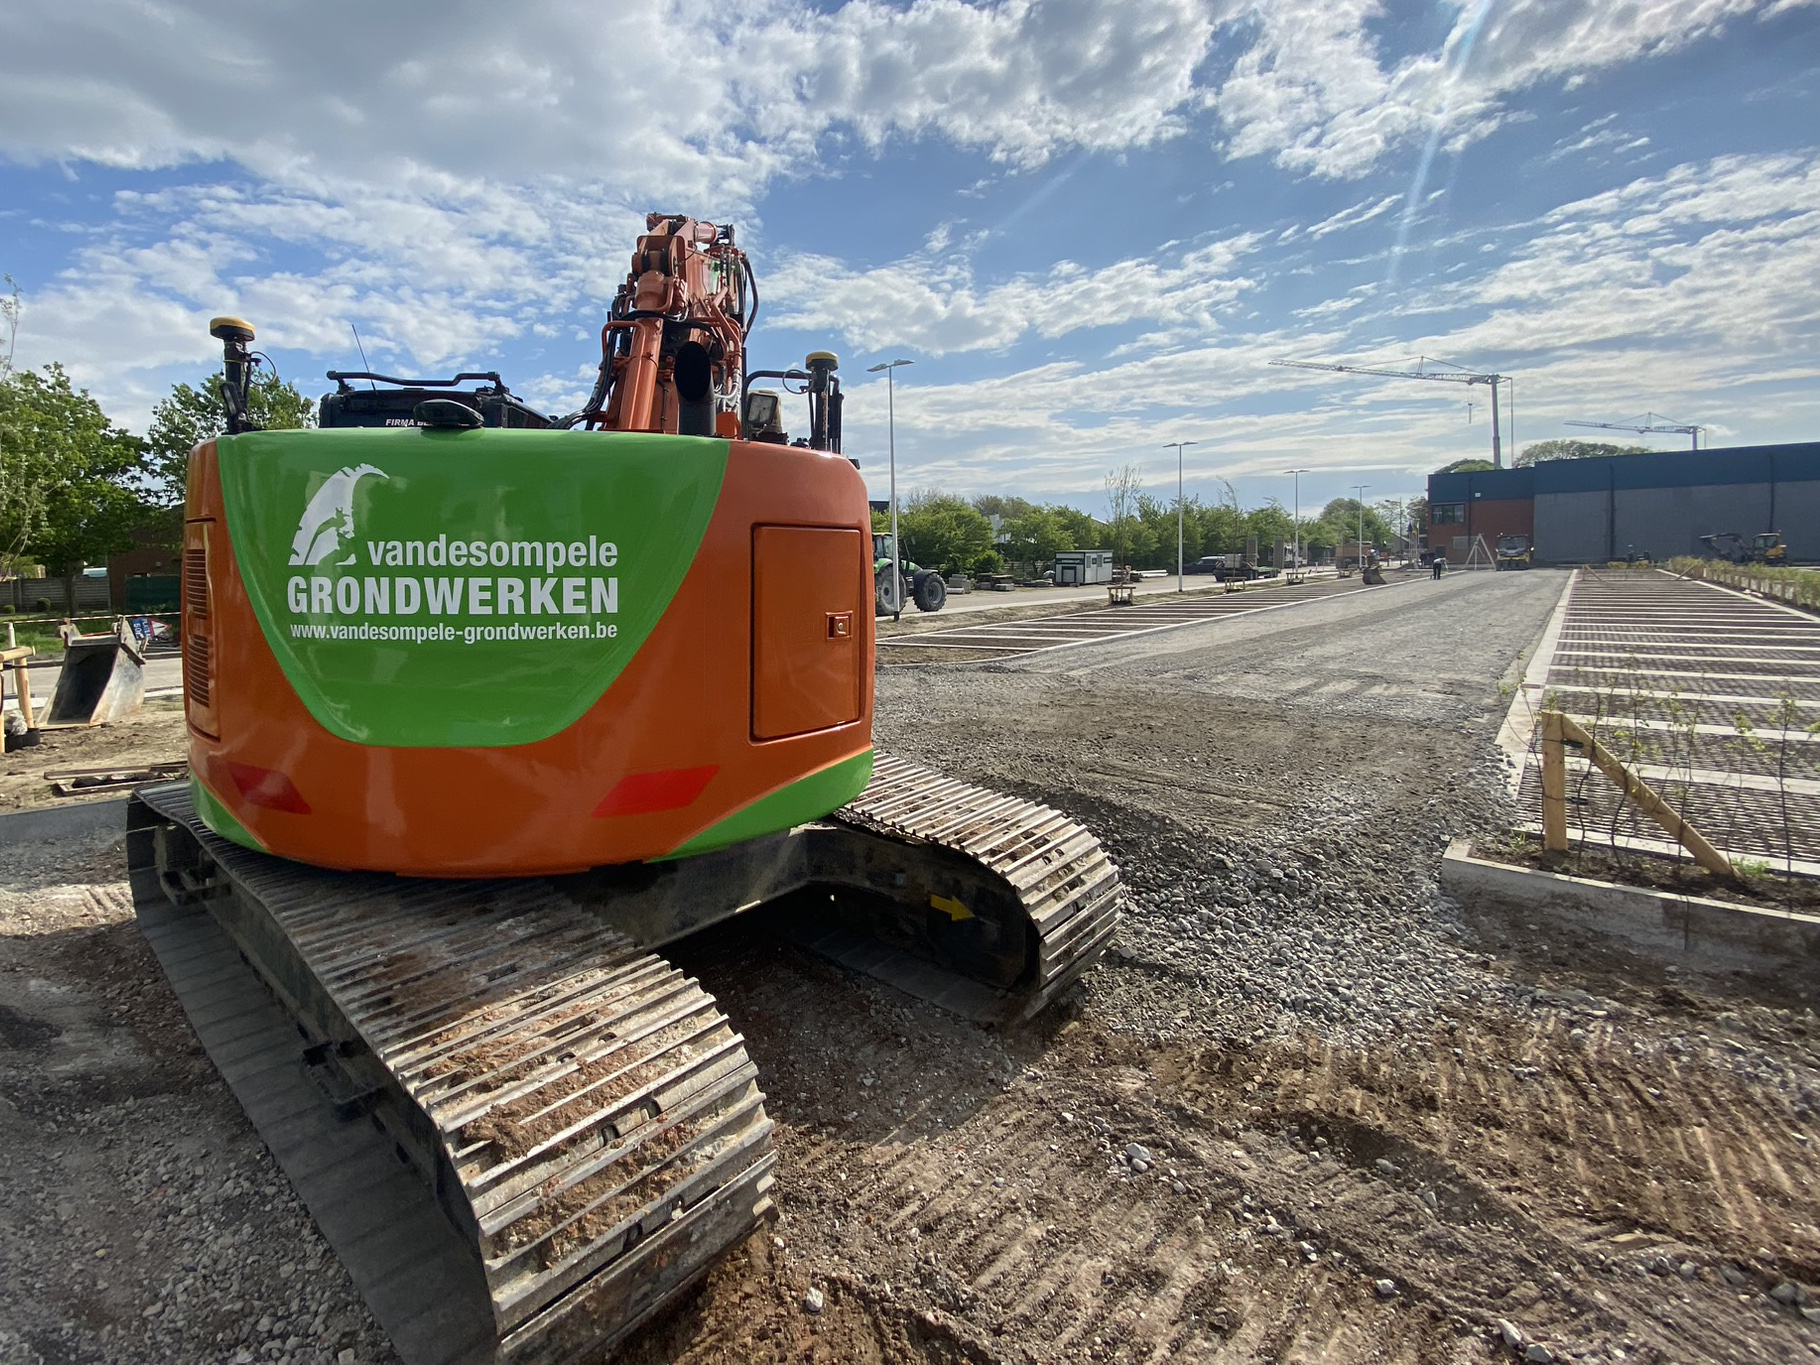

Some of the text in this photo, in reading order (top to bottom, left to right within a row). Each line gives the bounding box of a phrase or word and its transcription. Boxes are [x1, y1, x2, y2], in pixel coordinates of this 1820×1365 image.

[385, 418, 415, 427] FIRMA
[367, 533, 618, 574] vandesompele
[287, 575, 619, 615] GRONDWERKEN
[290, 621, 618, 644] www.vandesompele-grondwerken.be
